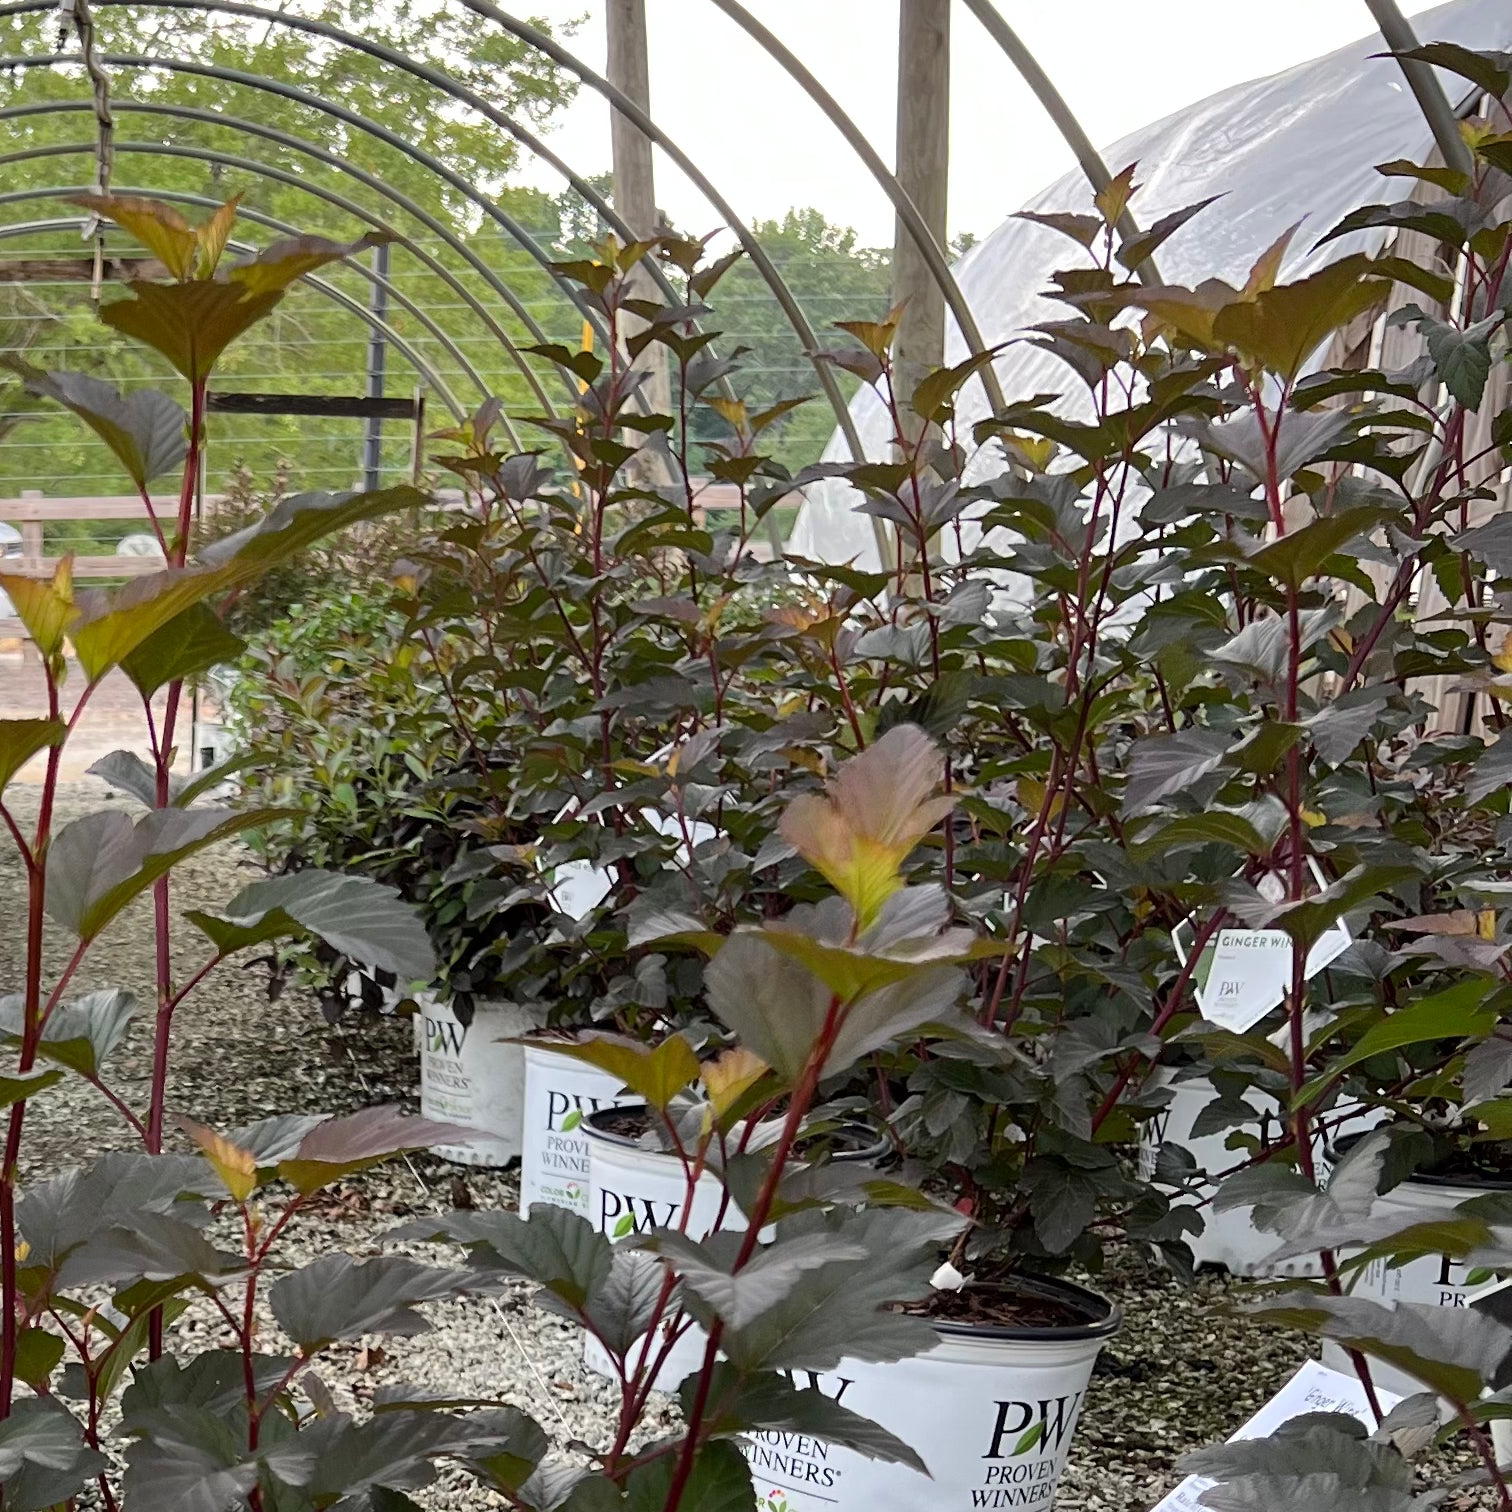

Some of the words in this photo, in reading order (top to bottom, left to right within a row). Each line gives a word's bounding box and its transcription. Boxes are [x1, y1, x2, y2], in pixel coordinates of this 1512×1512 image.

[1222, 936, 1267, 948] GINGER
[1271, 936, 1294, 948] WIN
[981, 1391, 1082, 1458] PW
